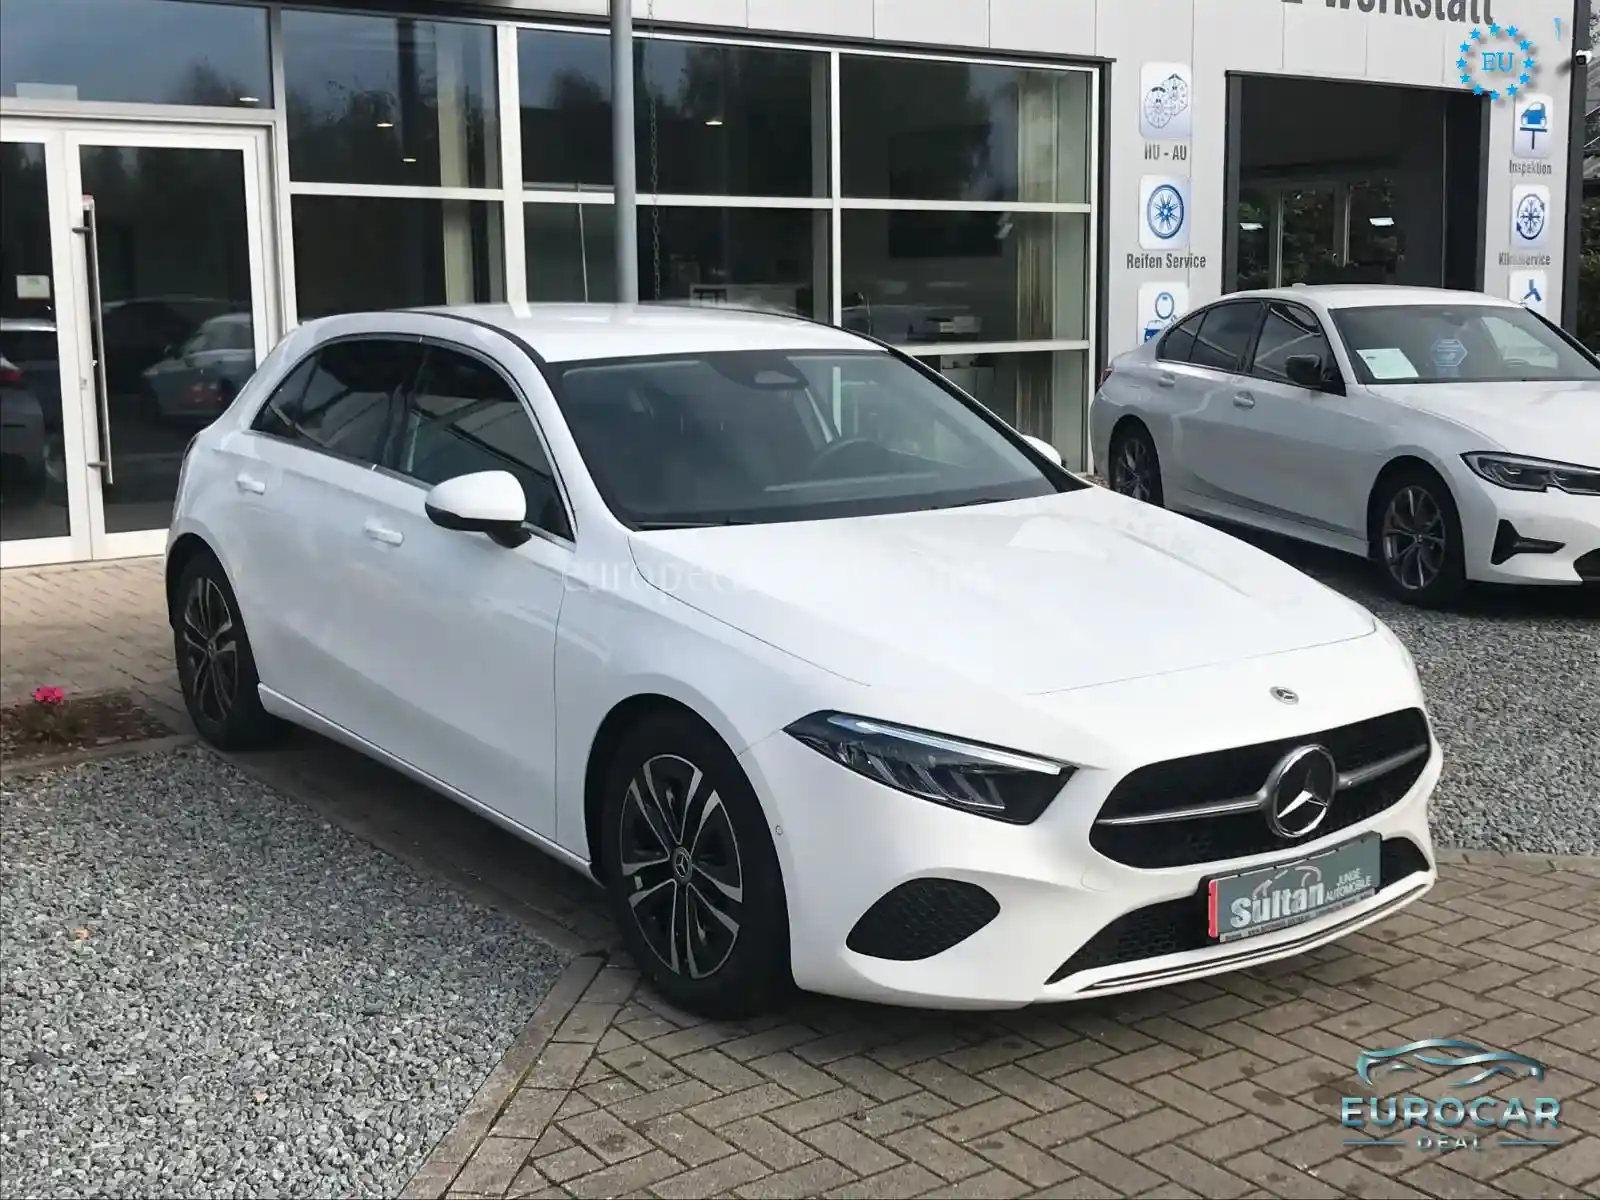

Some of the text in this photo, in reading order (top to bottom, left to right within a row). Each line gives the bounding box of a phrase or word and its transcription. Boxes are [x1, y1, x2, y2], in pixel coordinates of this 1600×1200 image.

[1325, 0, 1494, 25] erkstatt
[1172, 144, 1187, 160] AU
[1509, 159, 1552, 176] Inspektion
[1126, 252, 1206, 269] Reifen Service
[1499, 251, 1551, 266] Kliervice
